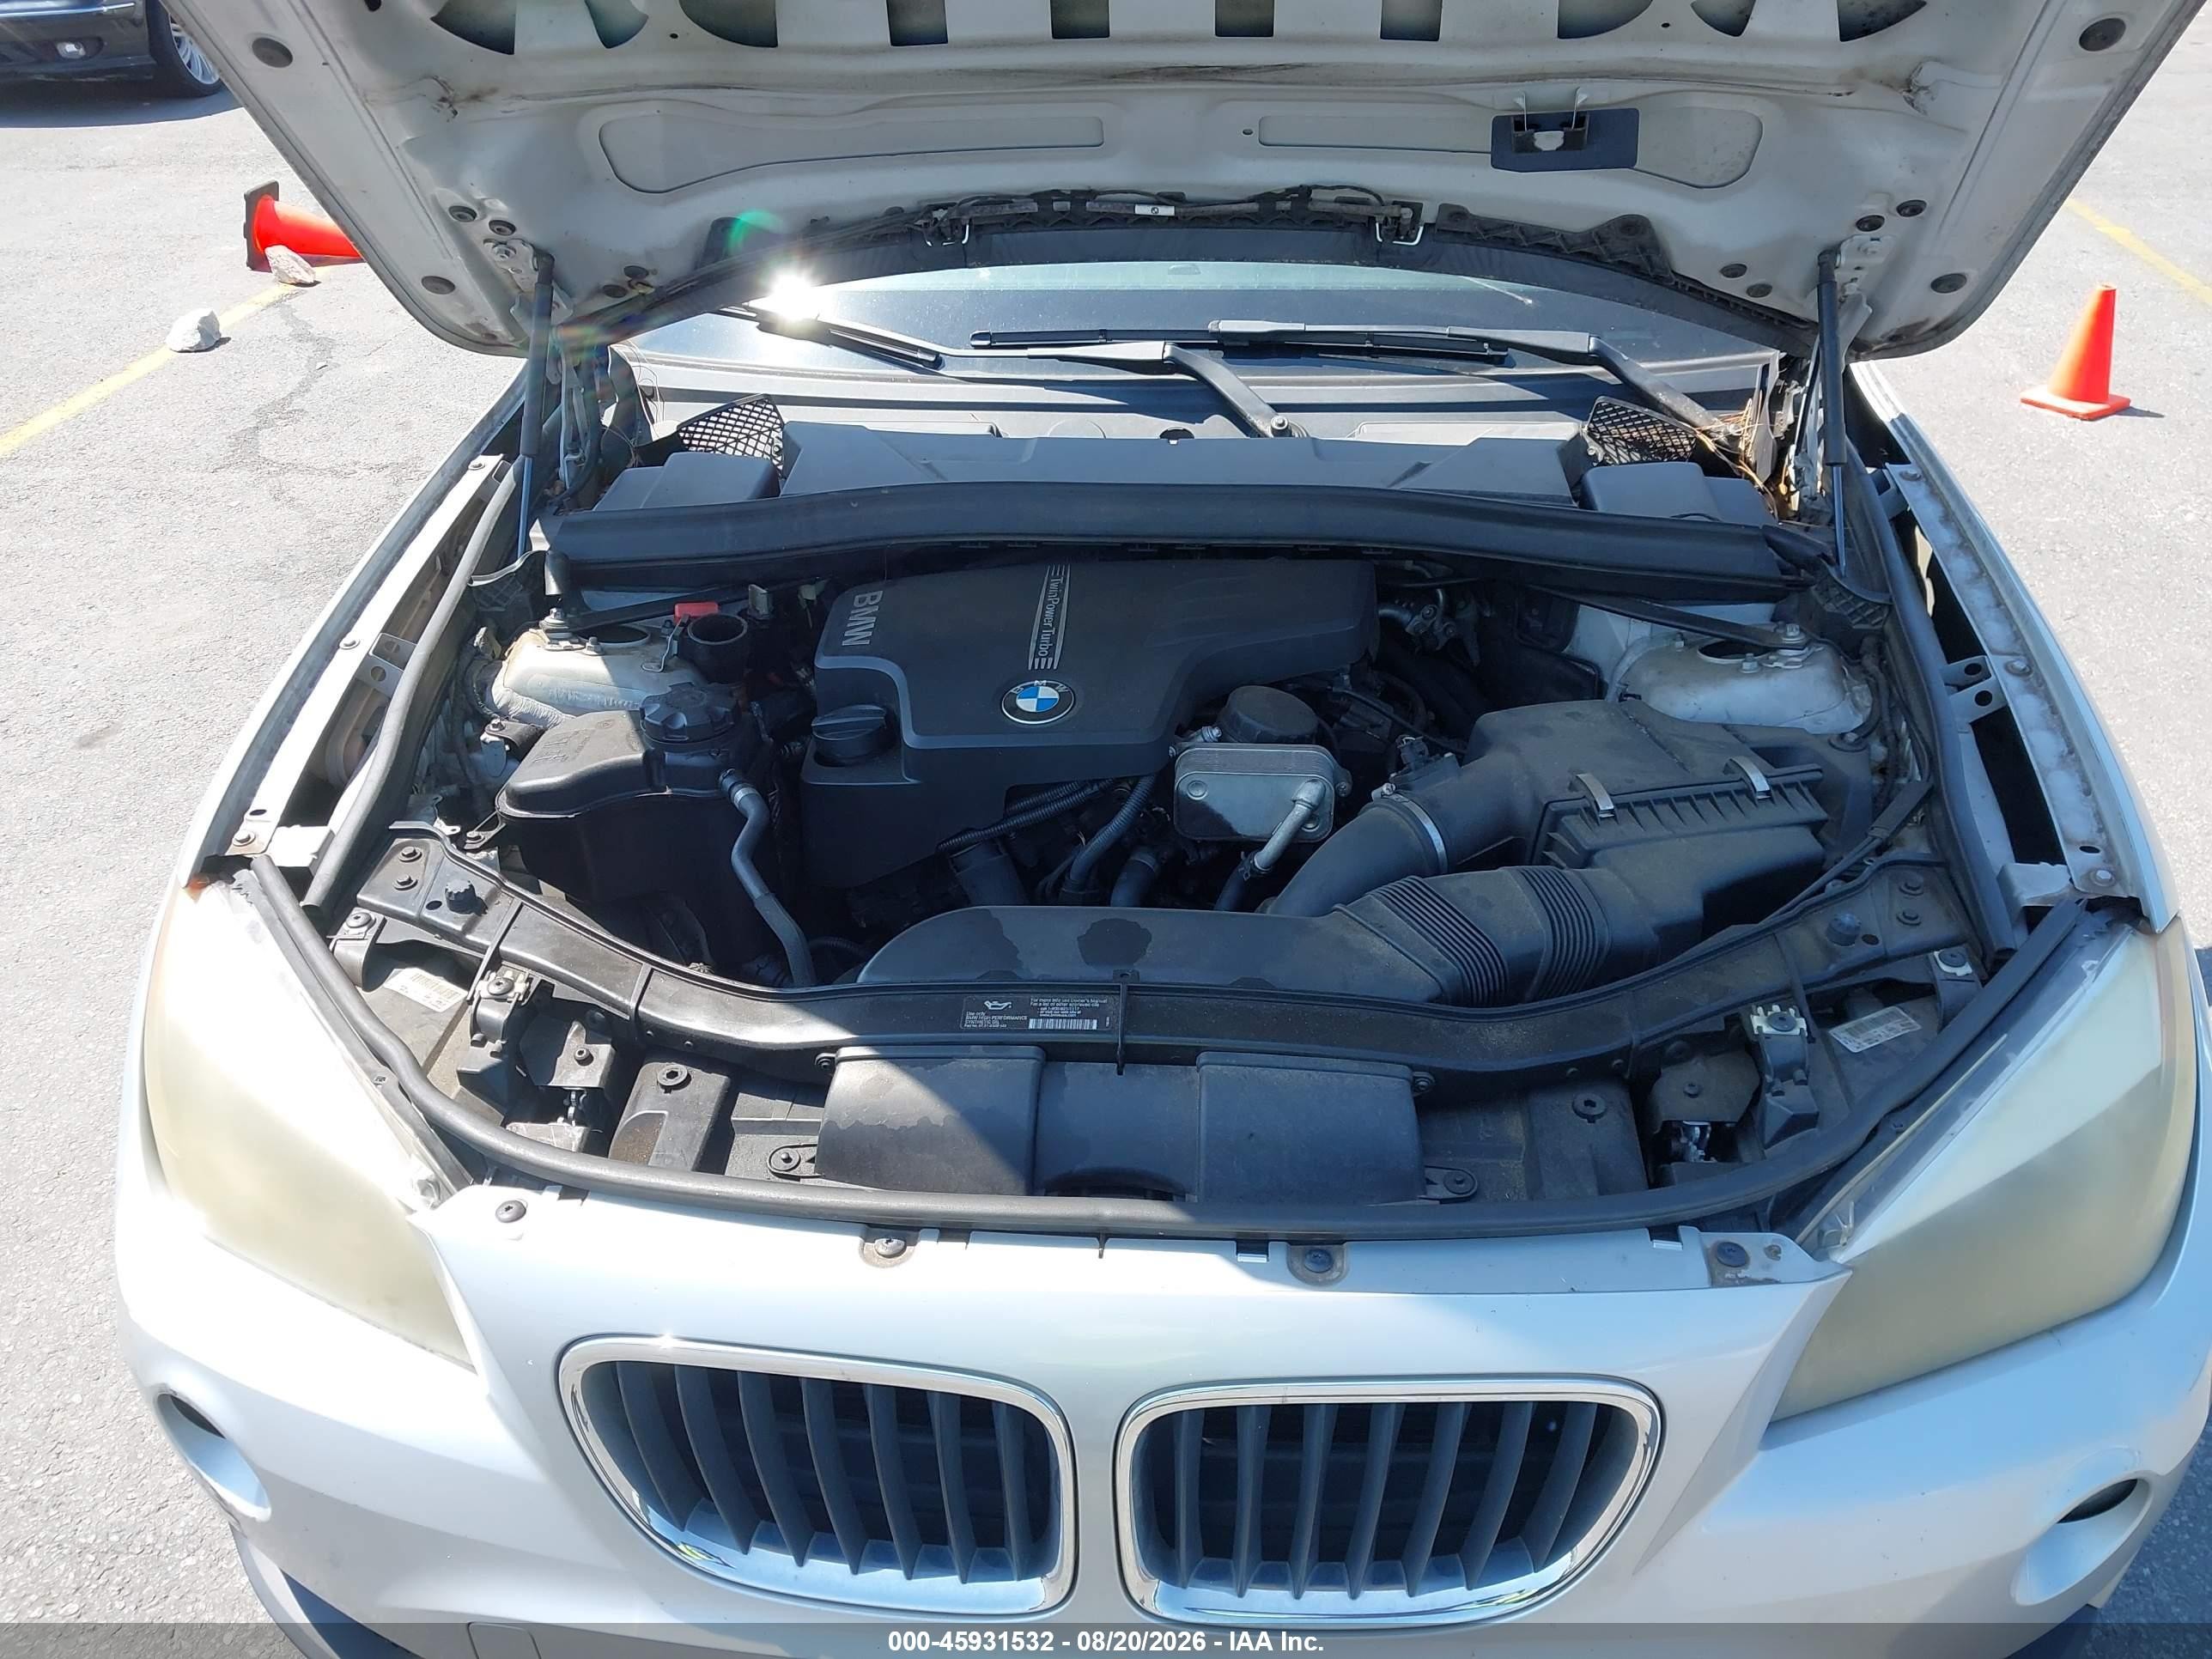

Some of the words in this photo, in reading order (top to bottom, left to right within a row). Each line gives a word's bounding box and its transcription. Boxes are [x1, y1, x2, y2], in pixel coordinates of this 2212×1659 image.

[842, 590, 884, 646] BMW
[1042, 576, 1064, 626] TwinPower
[1037, 627, 1055, 657] Turbo
[1010, 679, 1070, 694] BMW
